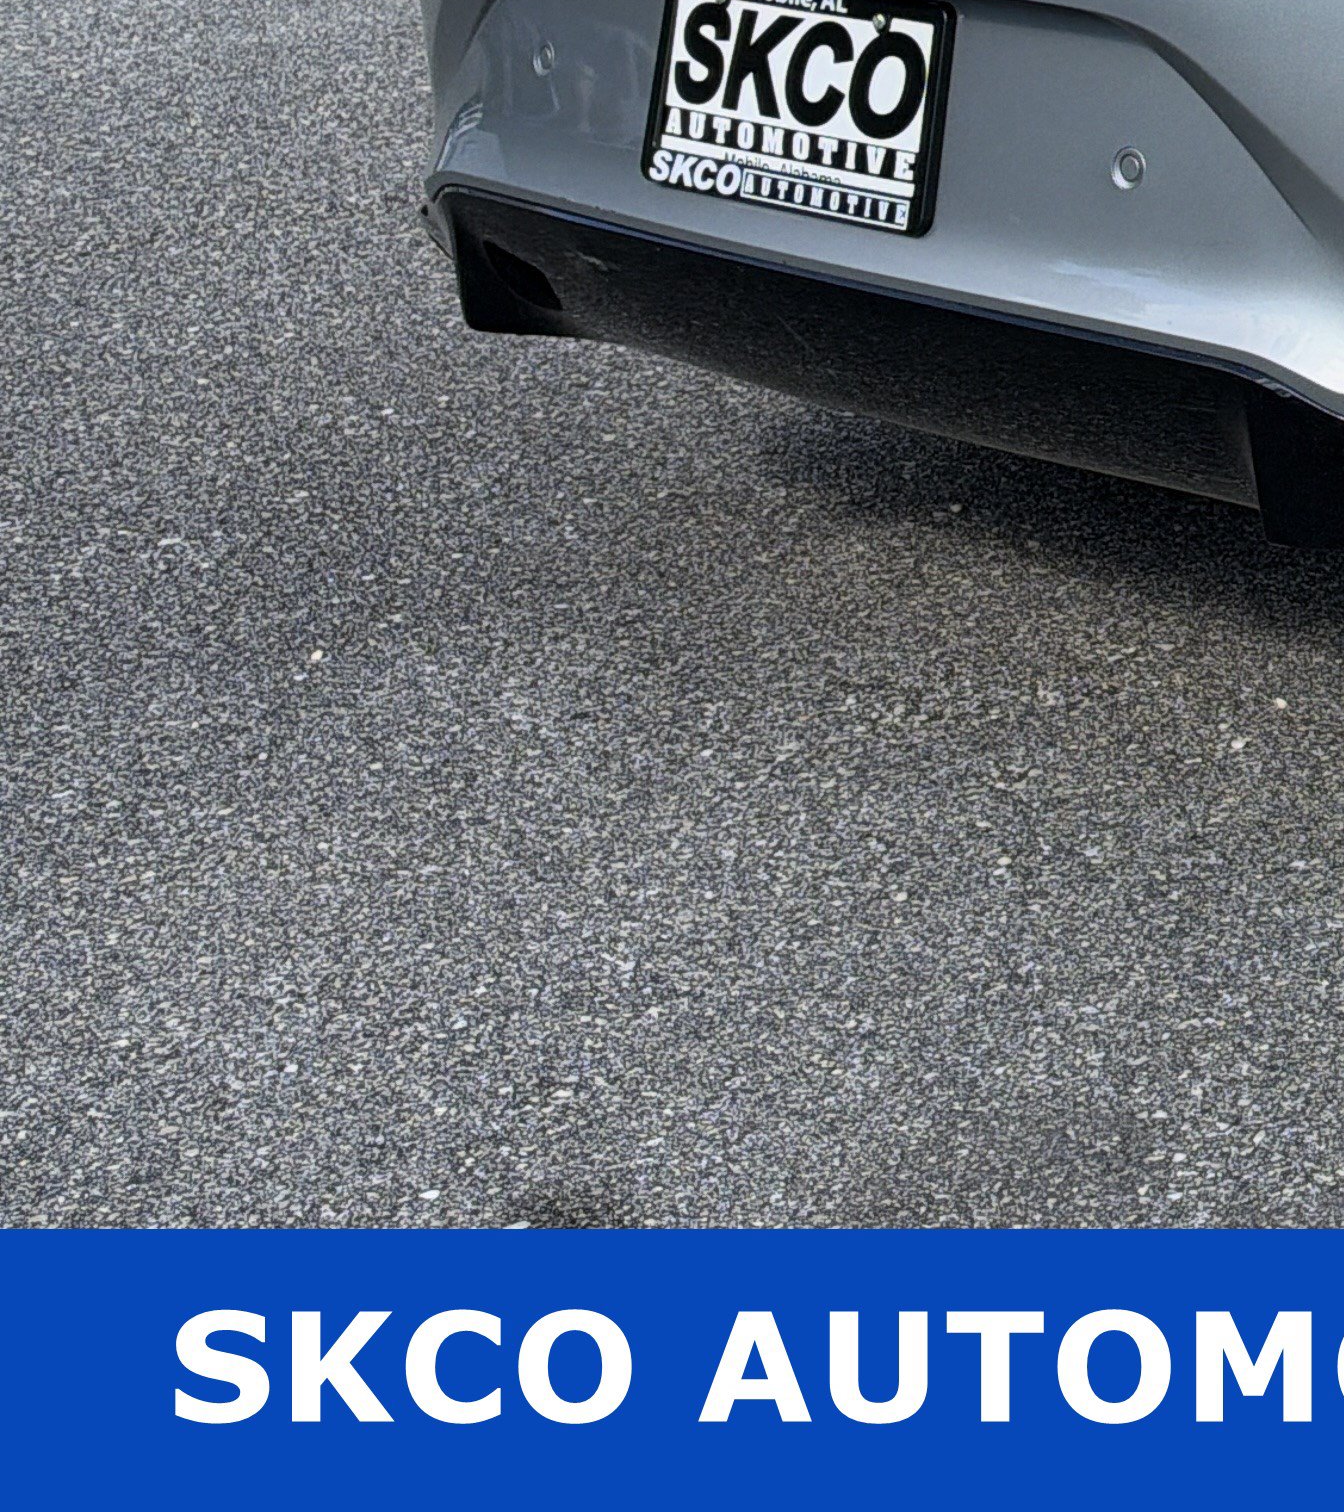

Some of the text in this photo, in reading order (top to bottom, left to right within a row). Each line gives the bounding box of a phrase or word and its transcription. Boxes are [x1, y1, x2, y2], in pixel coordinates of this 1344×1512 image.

[675, 2, 927, 139] SKCO
[649, 150, 741, 197] SKCO
[666, 108, 915, 181] AUTOMOTIVE
[744, 174, 907, 224] AUTOMOTIVE
